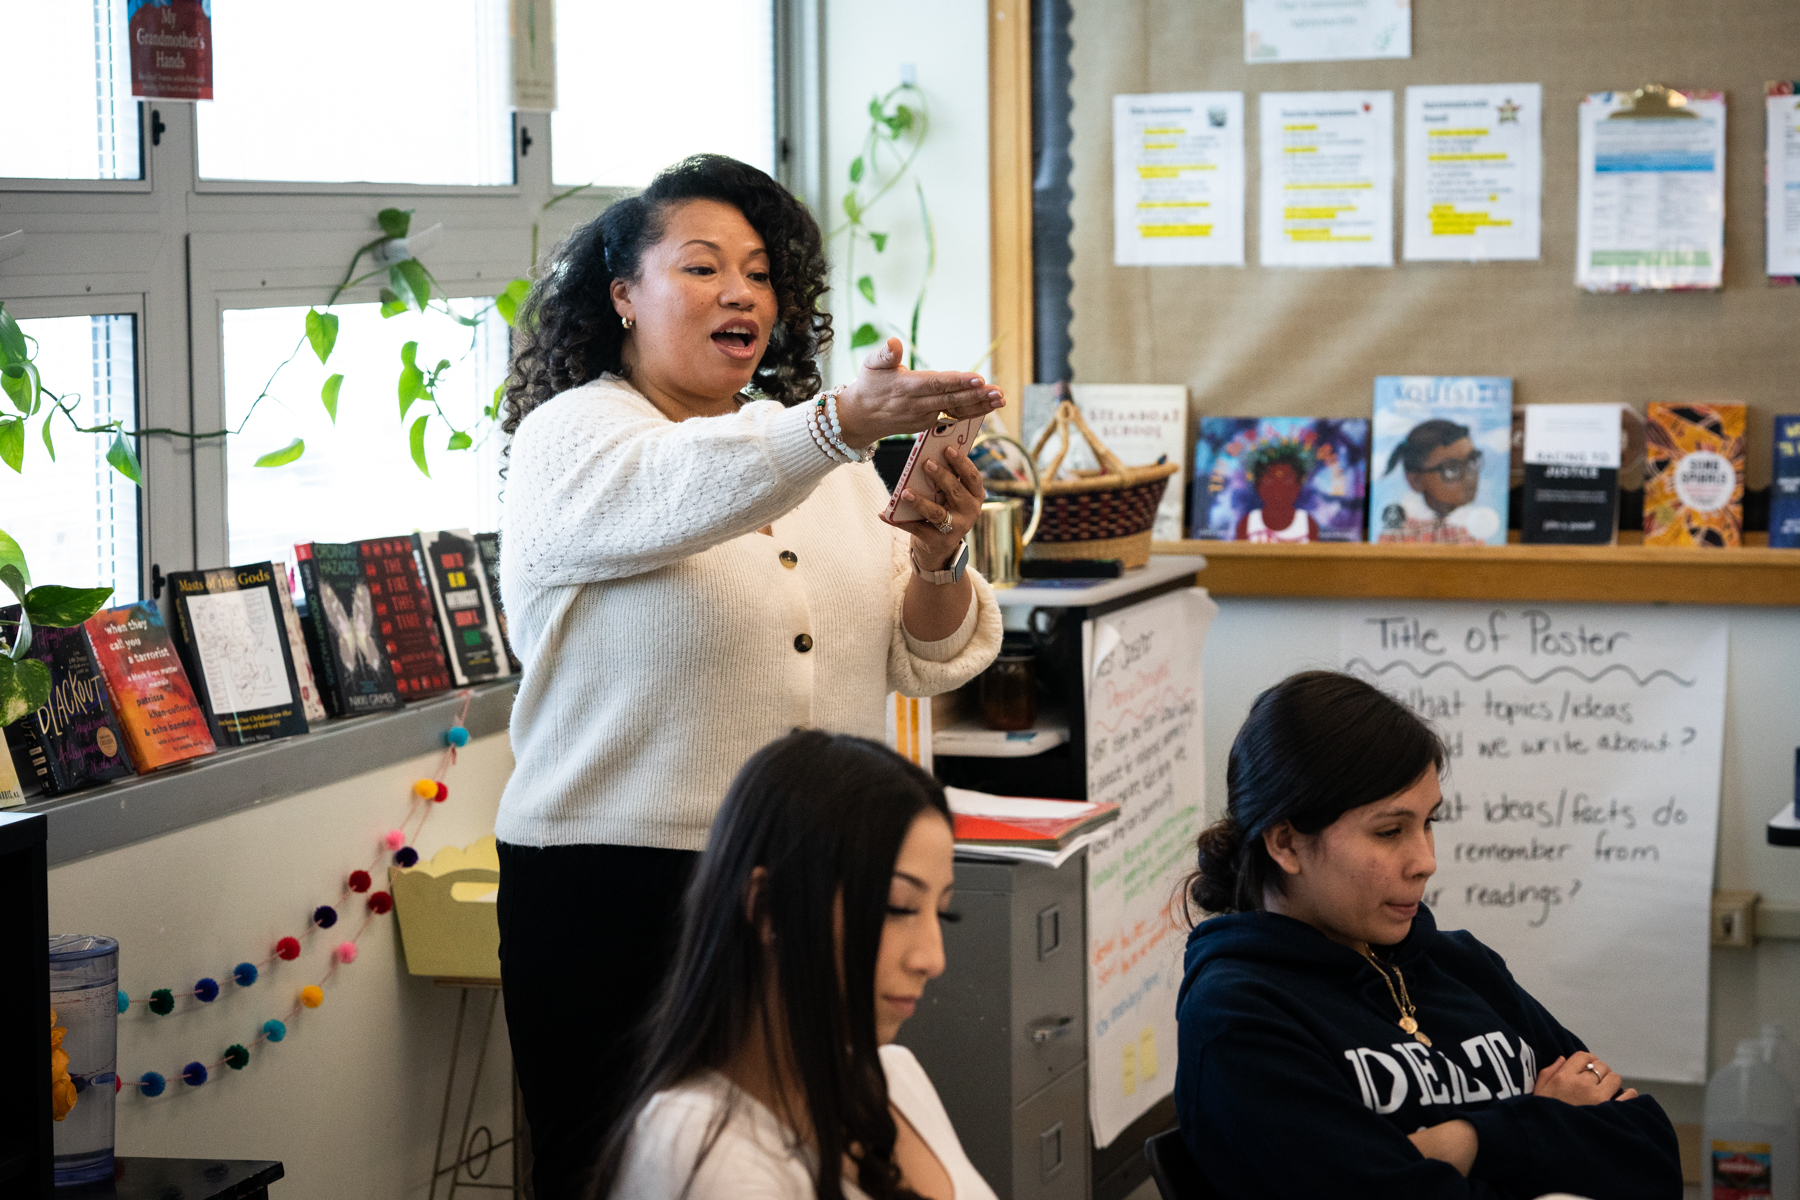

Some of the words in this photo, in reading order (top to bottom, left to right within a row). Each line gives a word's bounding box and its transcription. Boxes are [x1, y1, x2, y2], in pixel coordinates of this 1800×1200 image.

[161, 7, 176, 30] My
[136, 27, 206, 49] Grandmother's
[156, 50, 186, 69] Hands
[205, 577, 217, 590] of
[217, 575, 236, 588] the
[237, 569, 271, 586] Gods
[104, 622, 128, 635] when
[127, 619, 147, 631] they
[1365, 615, 1447, 656] Title
[1464, 608, 1509, 655] of
[1521, 608, 1631, 657] Poster
[109, 640, 125, 651] call
[125, 638, 141, 650] you
[128, 655, 134, 664] a
[134, 647, 170, 664] terrorist
[160, 665, 178, 676] matter
[136, 693, 164, 707] patrisse
[152, 723, 168, 735] asha
[169, 718, 197, 731] bandele
[1477, 735, 1512, 758] we
[1521, 731, 1590, 757] write
[1652, 794, 1689, 828] do
[1454, 835, 1575, 863] remember
[1594, 828, 1661, 864] from
[1465, 877, 1583, 929] readings?
